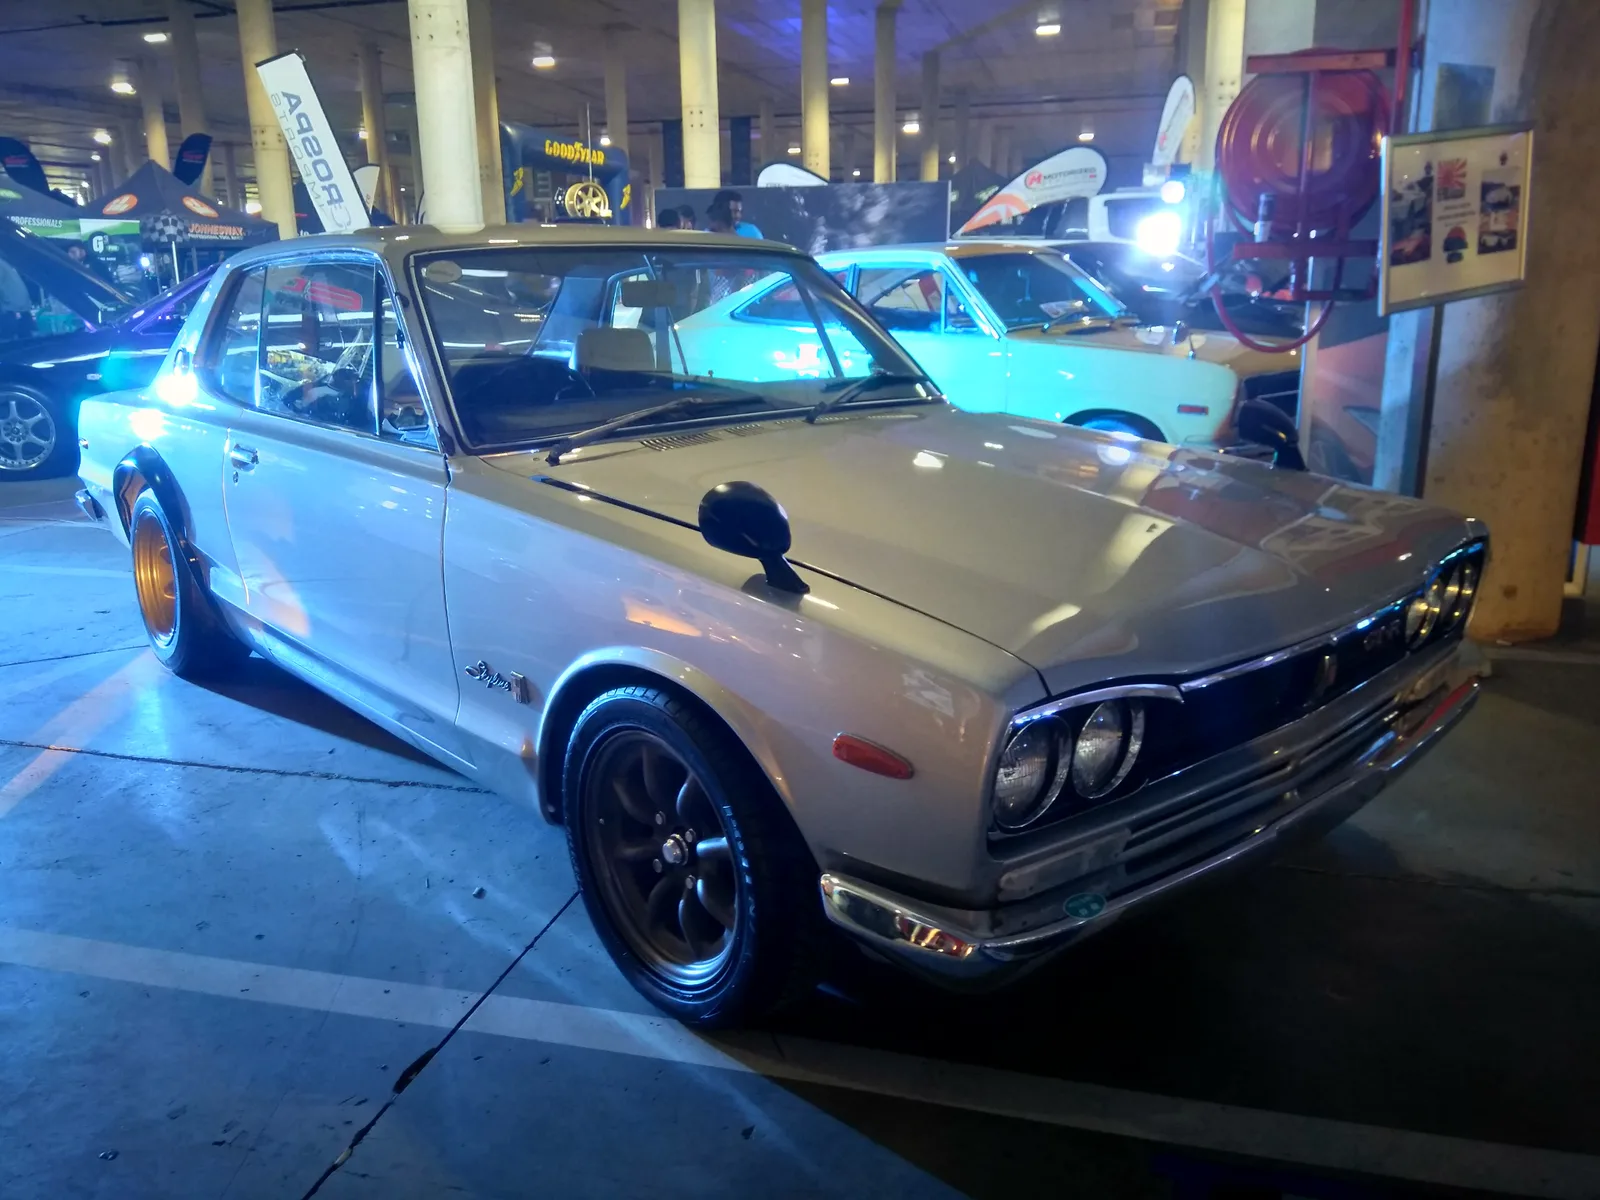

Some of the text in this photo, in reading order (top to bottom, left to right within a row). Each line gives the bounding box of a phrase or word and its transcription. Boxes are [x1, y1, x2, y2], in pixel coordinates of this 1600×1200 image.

[545, 139, 605, 165] GOODYEAR
[10, 215, 63, 228] PROFESSIONALS
[464, 660, 512, 691] Skyline
